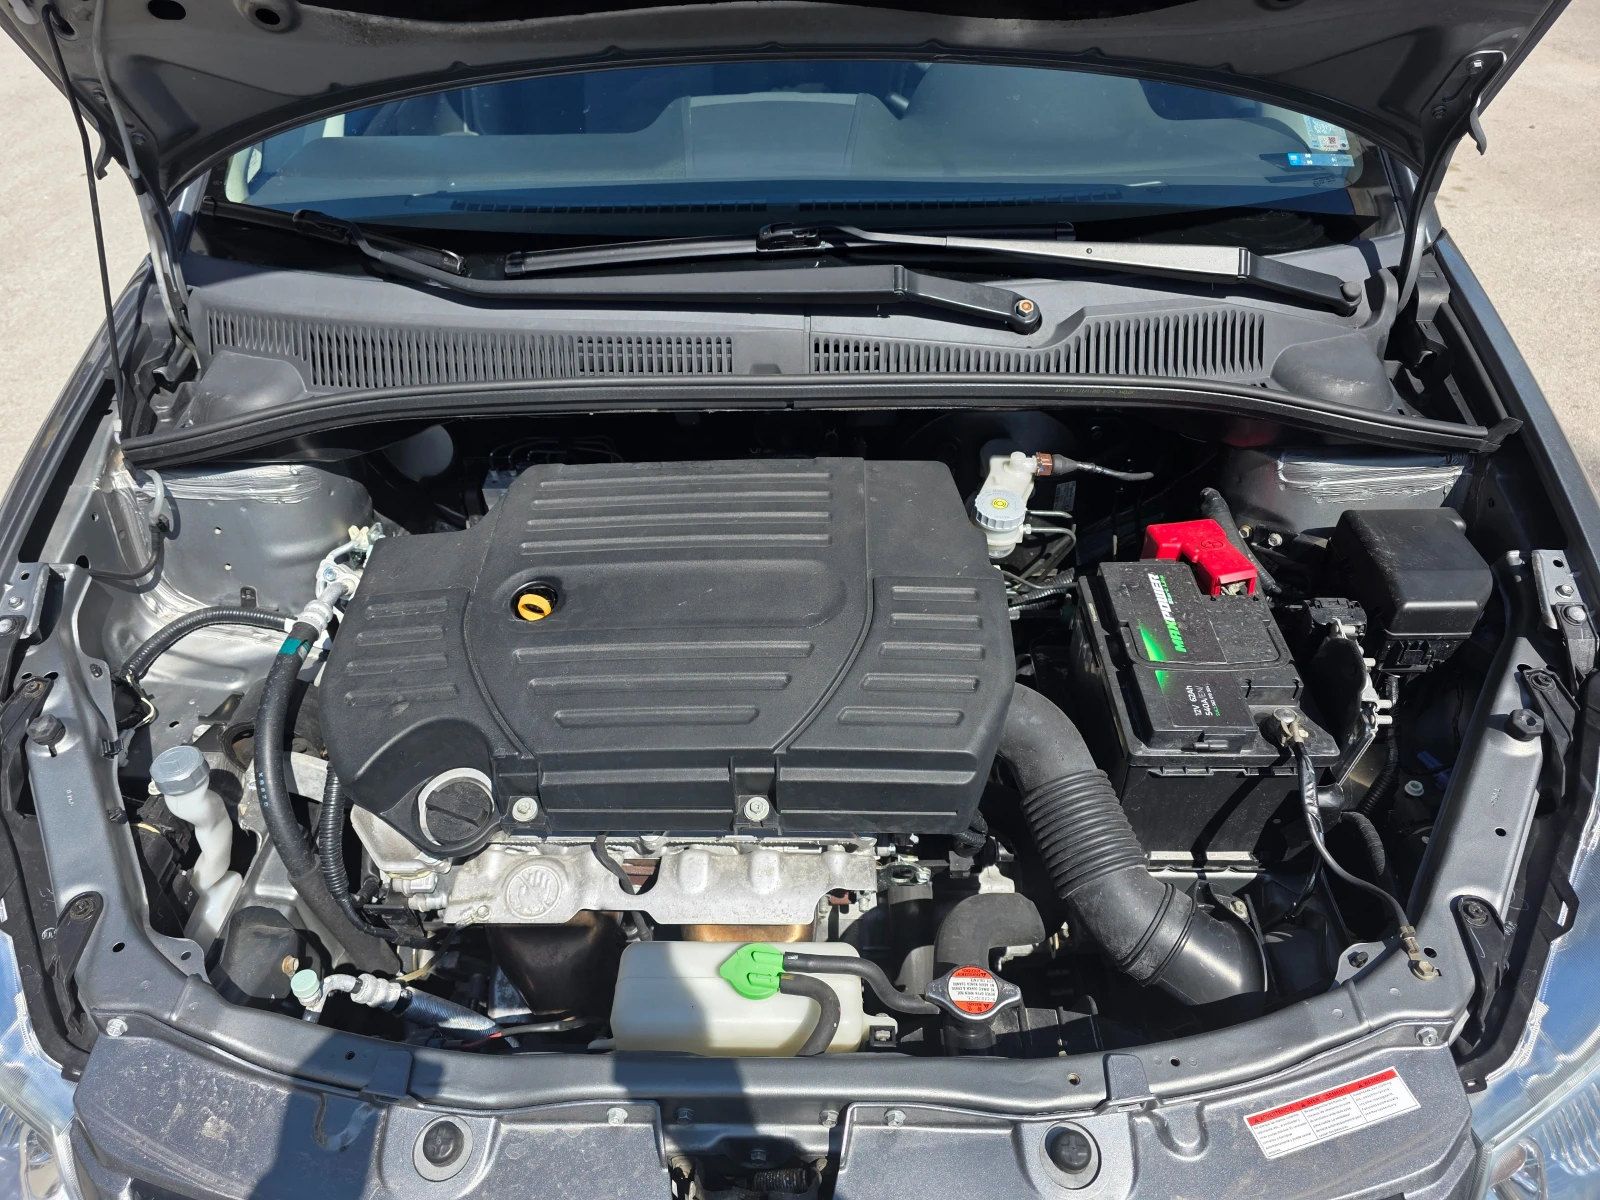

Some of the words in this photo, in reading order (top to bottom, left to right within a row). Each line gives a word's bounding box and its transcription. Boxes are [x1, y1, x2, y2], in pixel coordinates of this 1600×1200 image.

[1147, 572, 1187, 653] MAXPOWER
[1185, 685, 1198, 702] 62Ah
[1191, 704, 1203, 716] 12V
